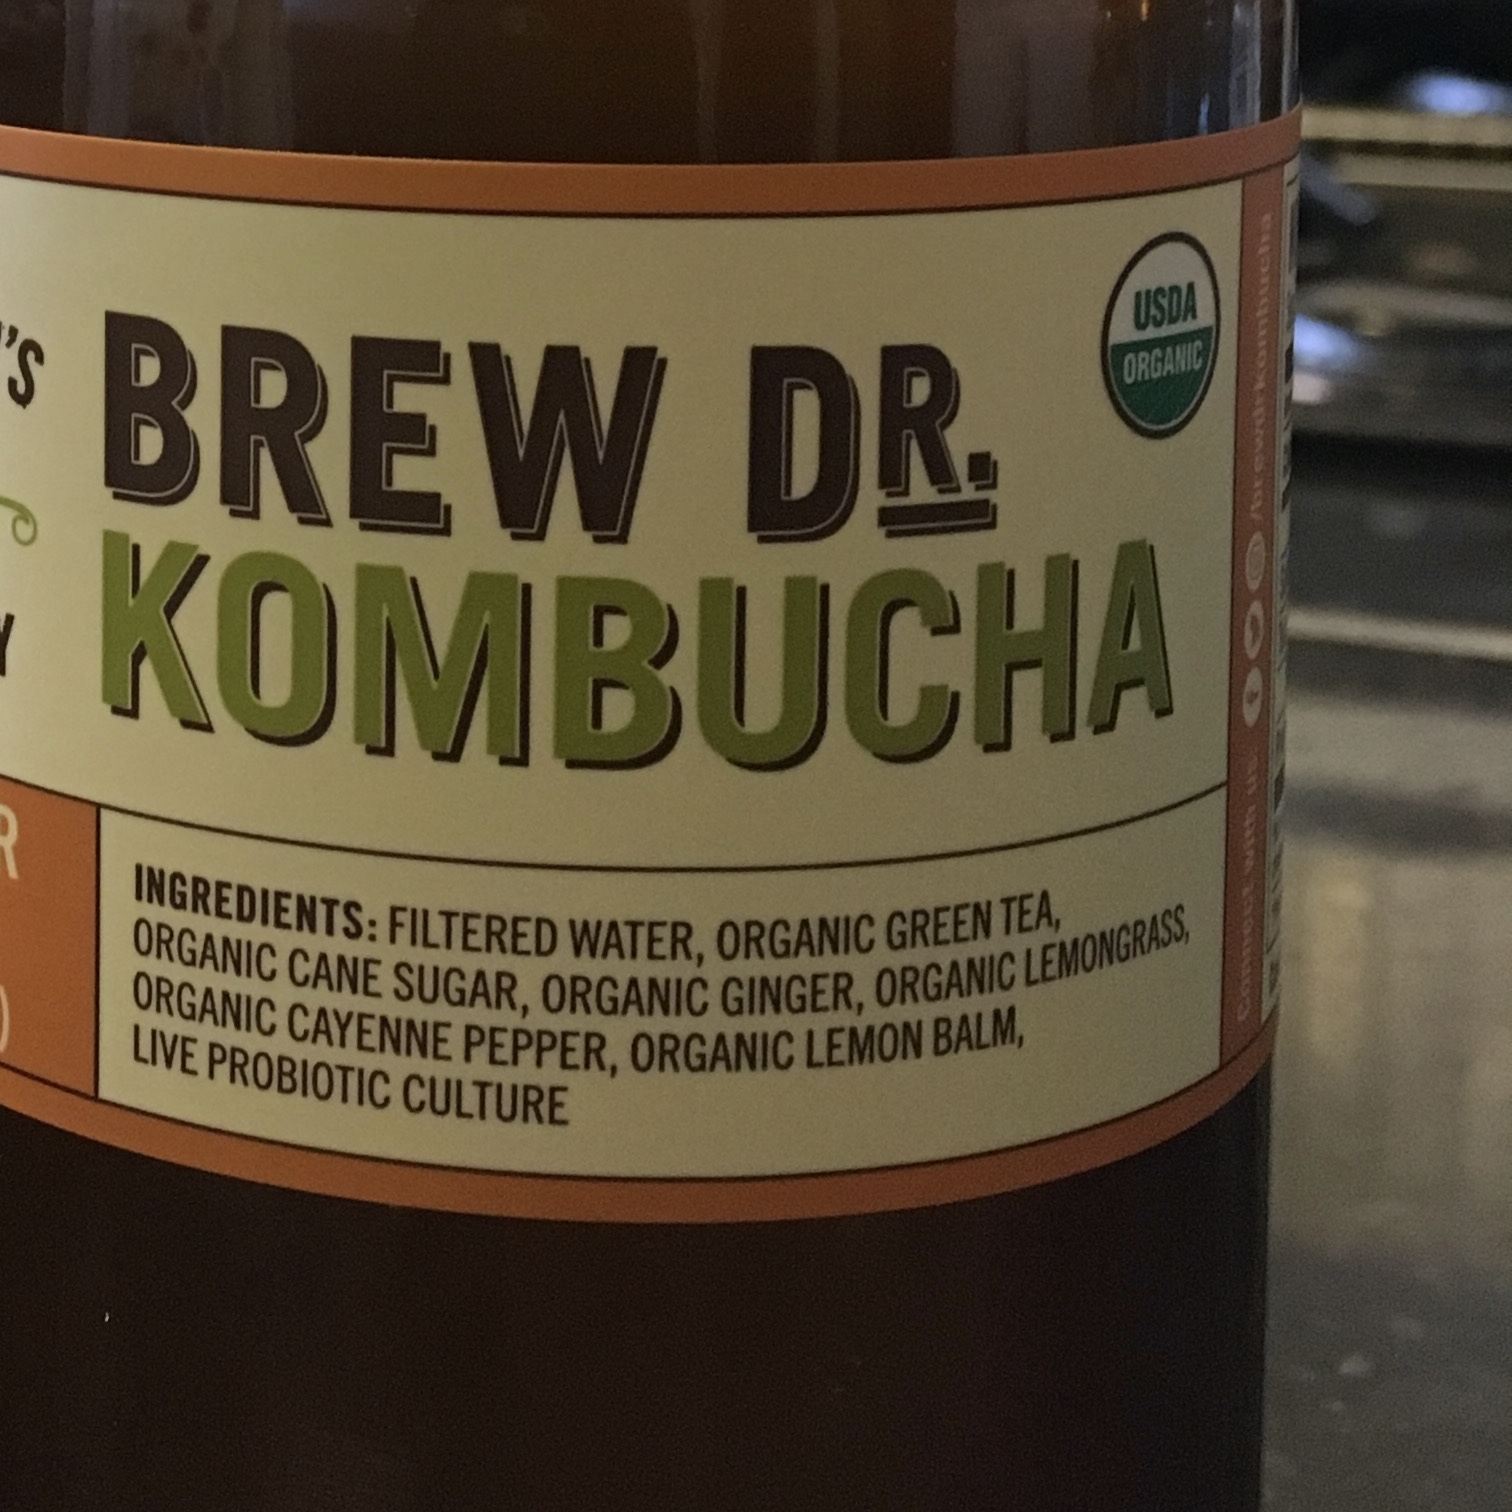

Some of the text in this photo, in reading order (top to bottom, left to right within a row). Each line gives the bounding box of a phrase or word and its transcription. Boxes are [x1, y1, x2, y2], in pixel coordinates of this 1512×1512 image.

[1133, 281, 1199, 331] USDA
[1123, 339, 1204, 386] ORGANIC
[101, 308, 999, 546] BREW DR.
[100, 528, 1175, 773] KOMBUCHA
[132, 902, 1192, 1020] ORGANIC CANE SUGAR, ORGANIC GINGER, ORGANIC LEMONGRASS,
[133, 861, 1063, 968] INGREDIENTS: FILTERED WATER, ORGANIC GREEN TEA,
[132, 971, 1026, 1080] ORGANIC CAYENNE PEPPER, ORGANIC LEMON BALM,
[132, 1023, 572, 1128] LIVE PROBIOTIC CULTURE
